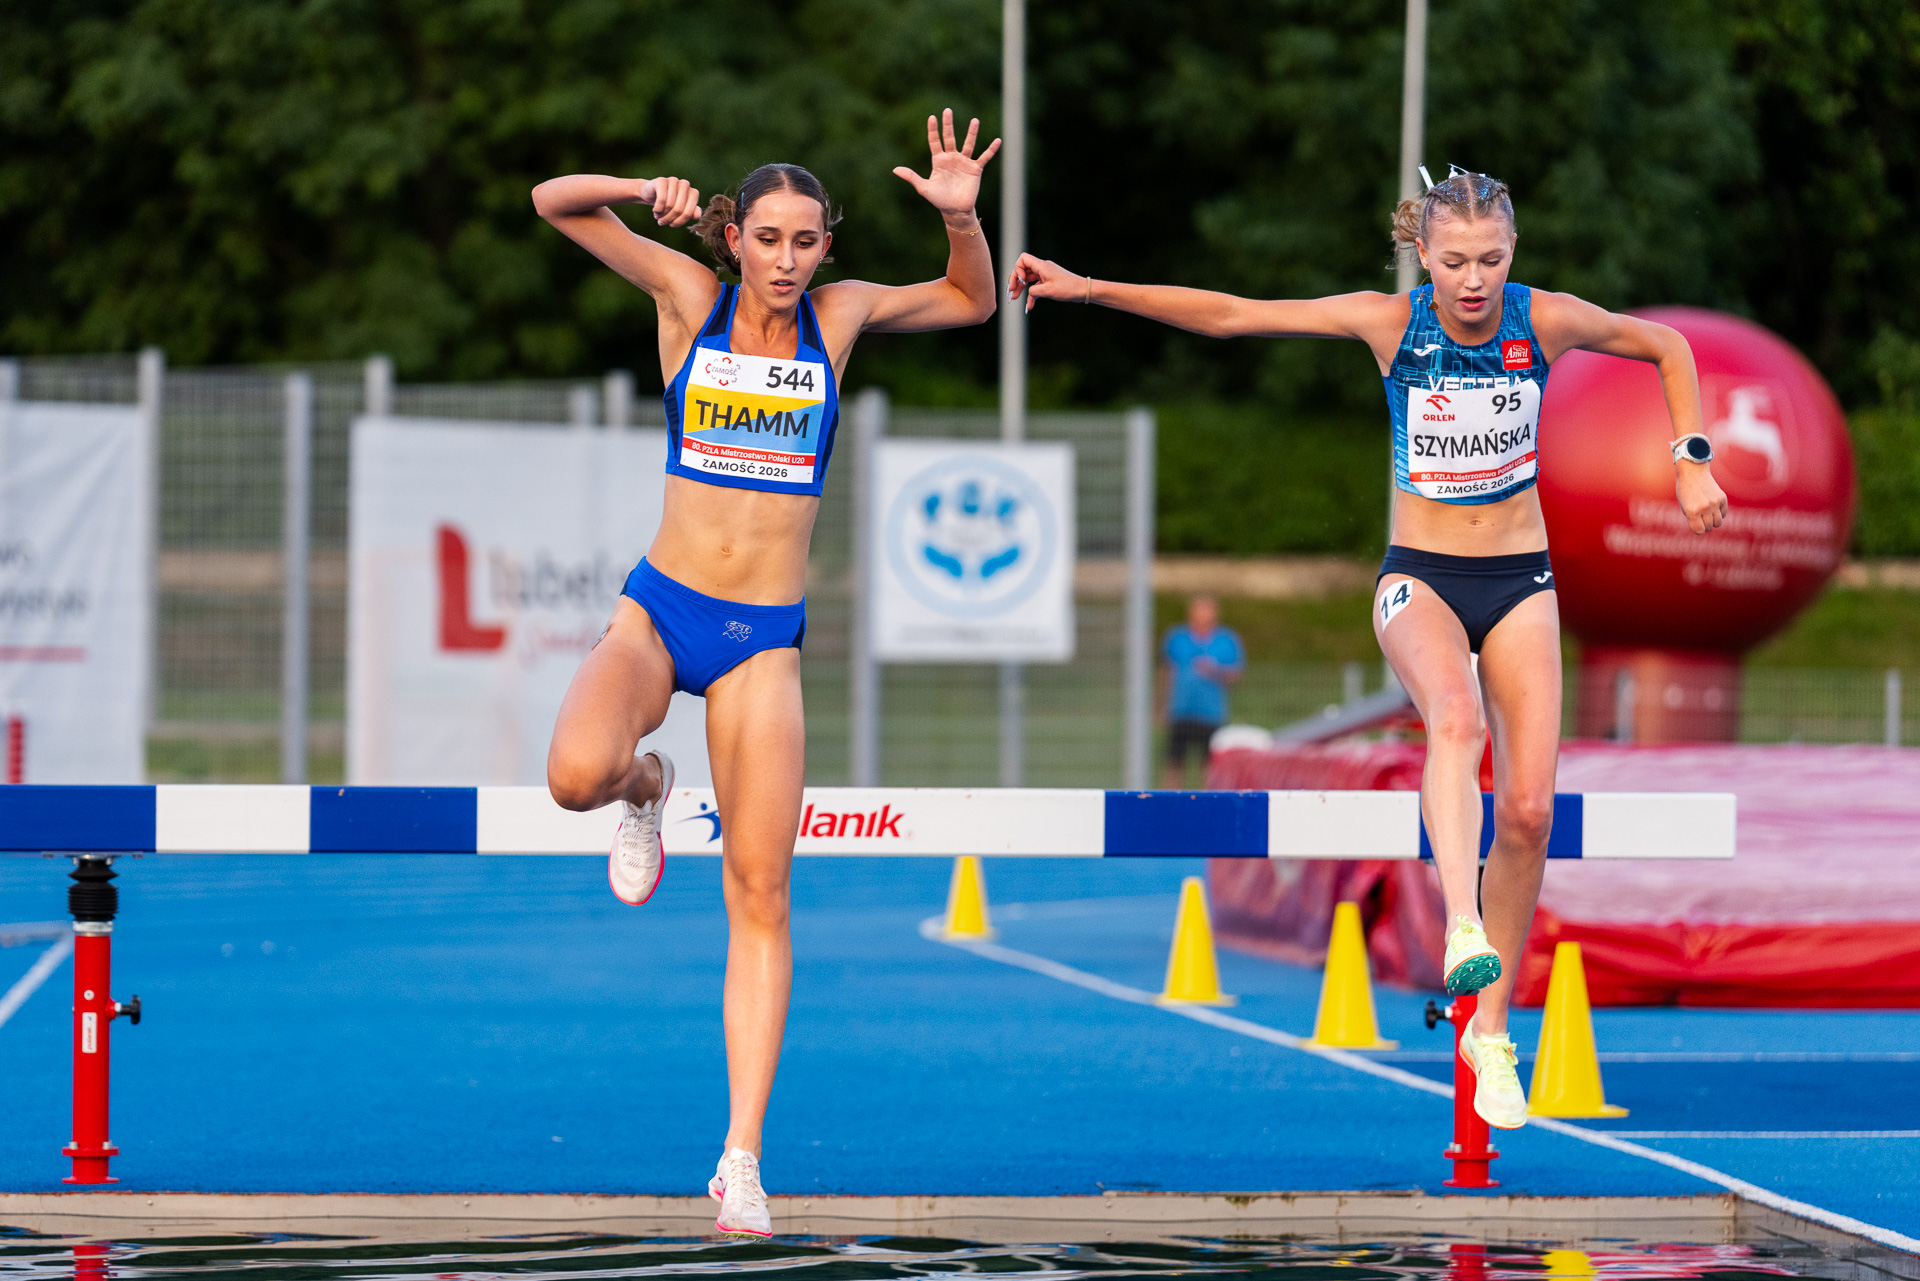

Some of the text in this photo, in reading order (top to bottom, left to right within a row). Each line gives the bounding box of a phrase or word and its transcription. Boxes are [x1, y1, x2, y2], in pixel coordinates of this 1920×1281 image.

[765, 365, 815, 392] 544
[1491, 391, 1522, 415] 95
[695, 399, 810, 439] THAMM
[1422, 413, 1455, 421] ORLEN
[691, 442, 702, 451] 80.
[701, 446, 720, 455] PZLA
[720, 449, 767, 460] Mistrzostwa
[767, 454, 790, 463] Polski
[1413, 423, 1531, 459] SZYMAŃSKA
[702, 459, 788, 478] ZAMOŚĆ 2026
[1420, 456, 1527, 481] 80. PZLA Mistrzostwa Polski U20
[1436, 473, 1515, 494] ZAMOŚĆ 2026
[1380, 583, 1411, 620] 14
[800, 803, 905, 838] lanik
